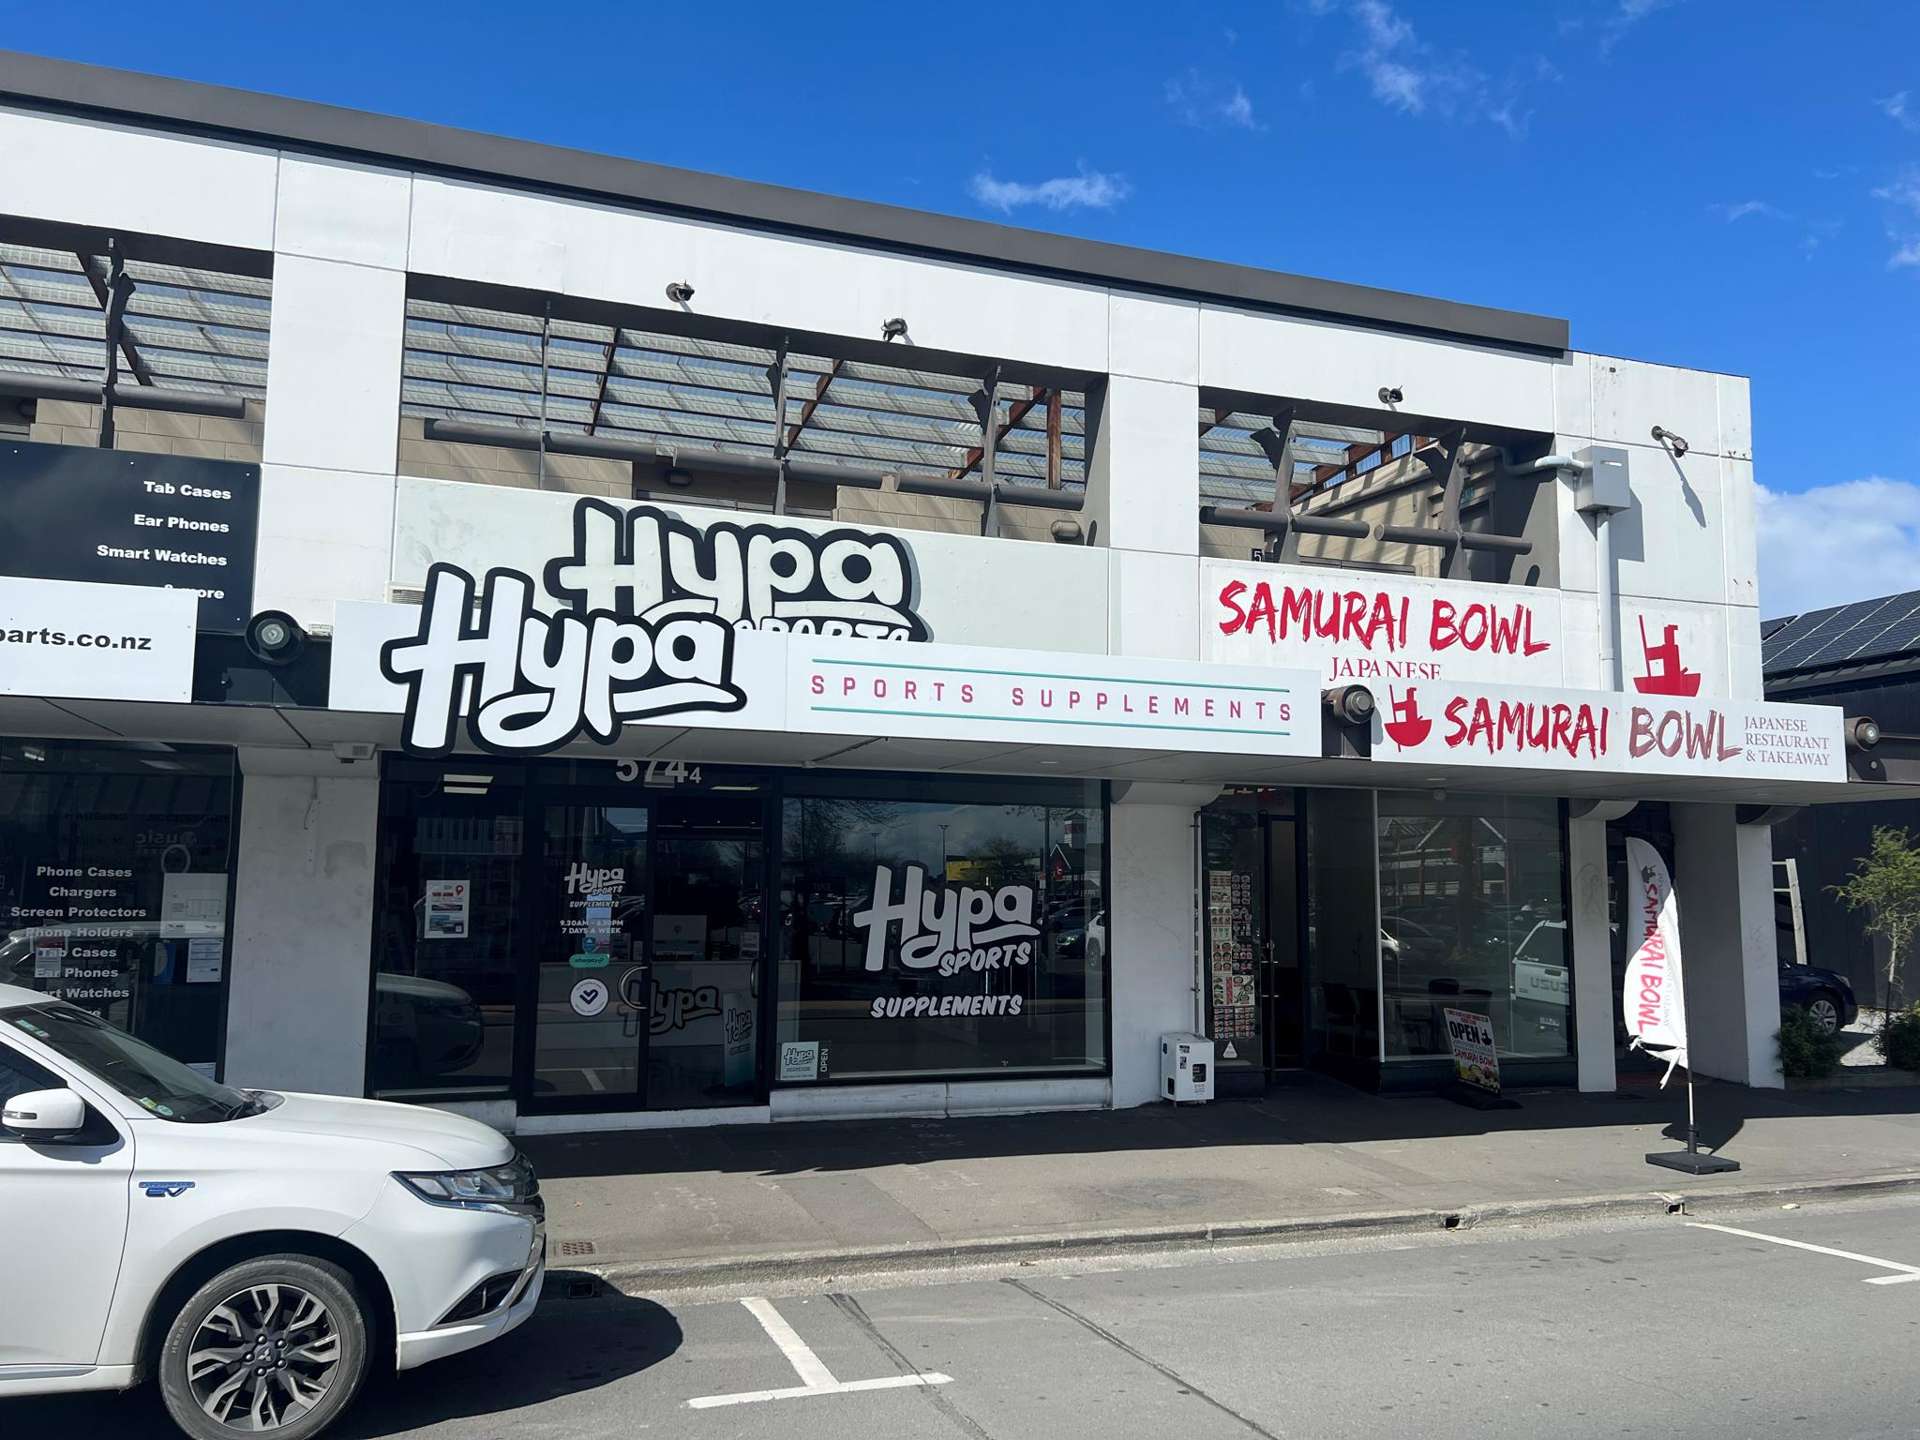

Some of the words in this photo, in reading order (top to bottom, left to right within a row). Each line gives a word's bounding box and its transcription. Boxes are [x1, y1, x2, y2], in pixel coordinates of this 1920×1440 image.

[144, 481, 175, 495] Tab
[181, 484, 232, 500] Cases
[134, 514, 163, 527] Ear
[168, 516, 230, 533] Phones
[97, 544, 150, 561] Smart
[155, 549, 227, 566] Watches
[545, 498, 928, 630] Hypa
[1219, 580, 1410, 652] SAMURAI
[1429, 599, 1550, 657] BOWL
[382, 564, 746, 755] Hypa
[1329, 656, 1441, 682] JAPANESE
[811, 675, 974, 704] SPORTS
[1012, 687, 1292, 722] SUPPLEMENTS
[1444, 696, 1609, 760] SAMURAI
[1628, 706, 1743, 762] BOWL
[1744, 715, 1808, 732] JAPANESE
[1745, 732, 1830, 750] RESTAURANT
[1746, 750, 1755, 762] &
[1759, 750, 1831, 766] TAKEAWAY
[36, 866, 82, 877] Phone
[87, 867, 132, 878] Cases
[564, 861, 626, 895] Hypa
[49, 886, 117, 899] Chargers
[593, 886, 623, 895] SPORTS
[10, 907, 63, 918] Screen
[68, 906, 147, 918] Protectors
[853, 864, 1040, 972] Hypa
[26, 927, 71, 938] Phone
[77, 927, 134, 938] Holders
[1640, 882, 1666, 969] SAMURAI
[41, 947, 67, 958] Tab
[72, 947, 117, 958] Cases
[938, 941, 1032, 977] SPORTS
[36, 968, 61, 978] Ear
[65, 967, 119, 979] Phones
[67, 987, 130, 998] Watches
[1637, 974, 1663, 1034] BOWL
[871, 994, 1023, 1018] SUPPLEMENTS
[1450, 1020, 1481, 1045] OPEN
[820, 1048, 829, 1073] OPEN
